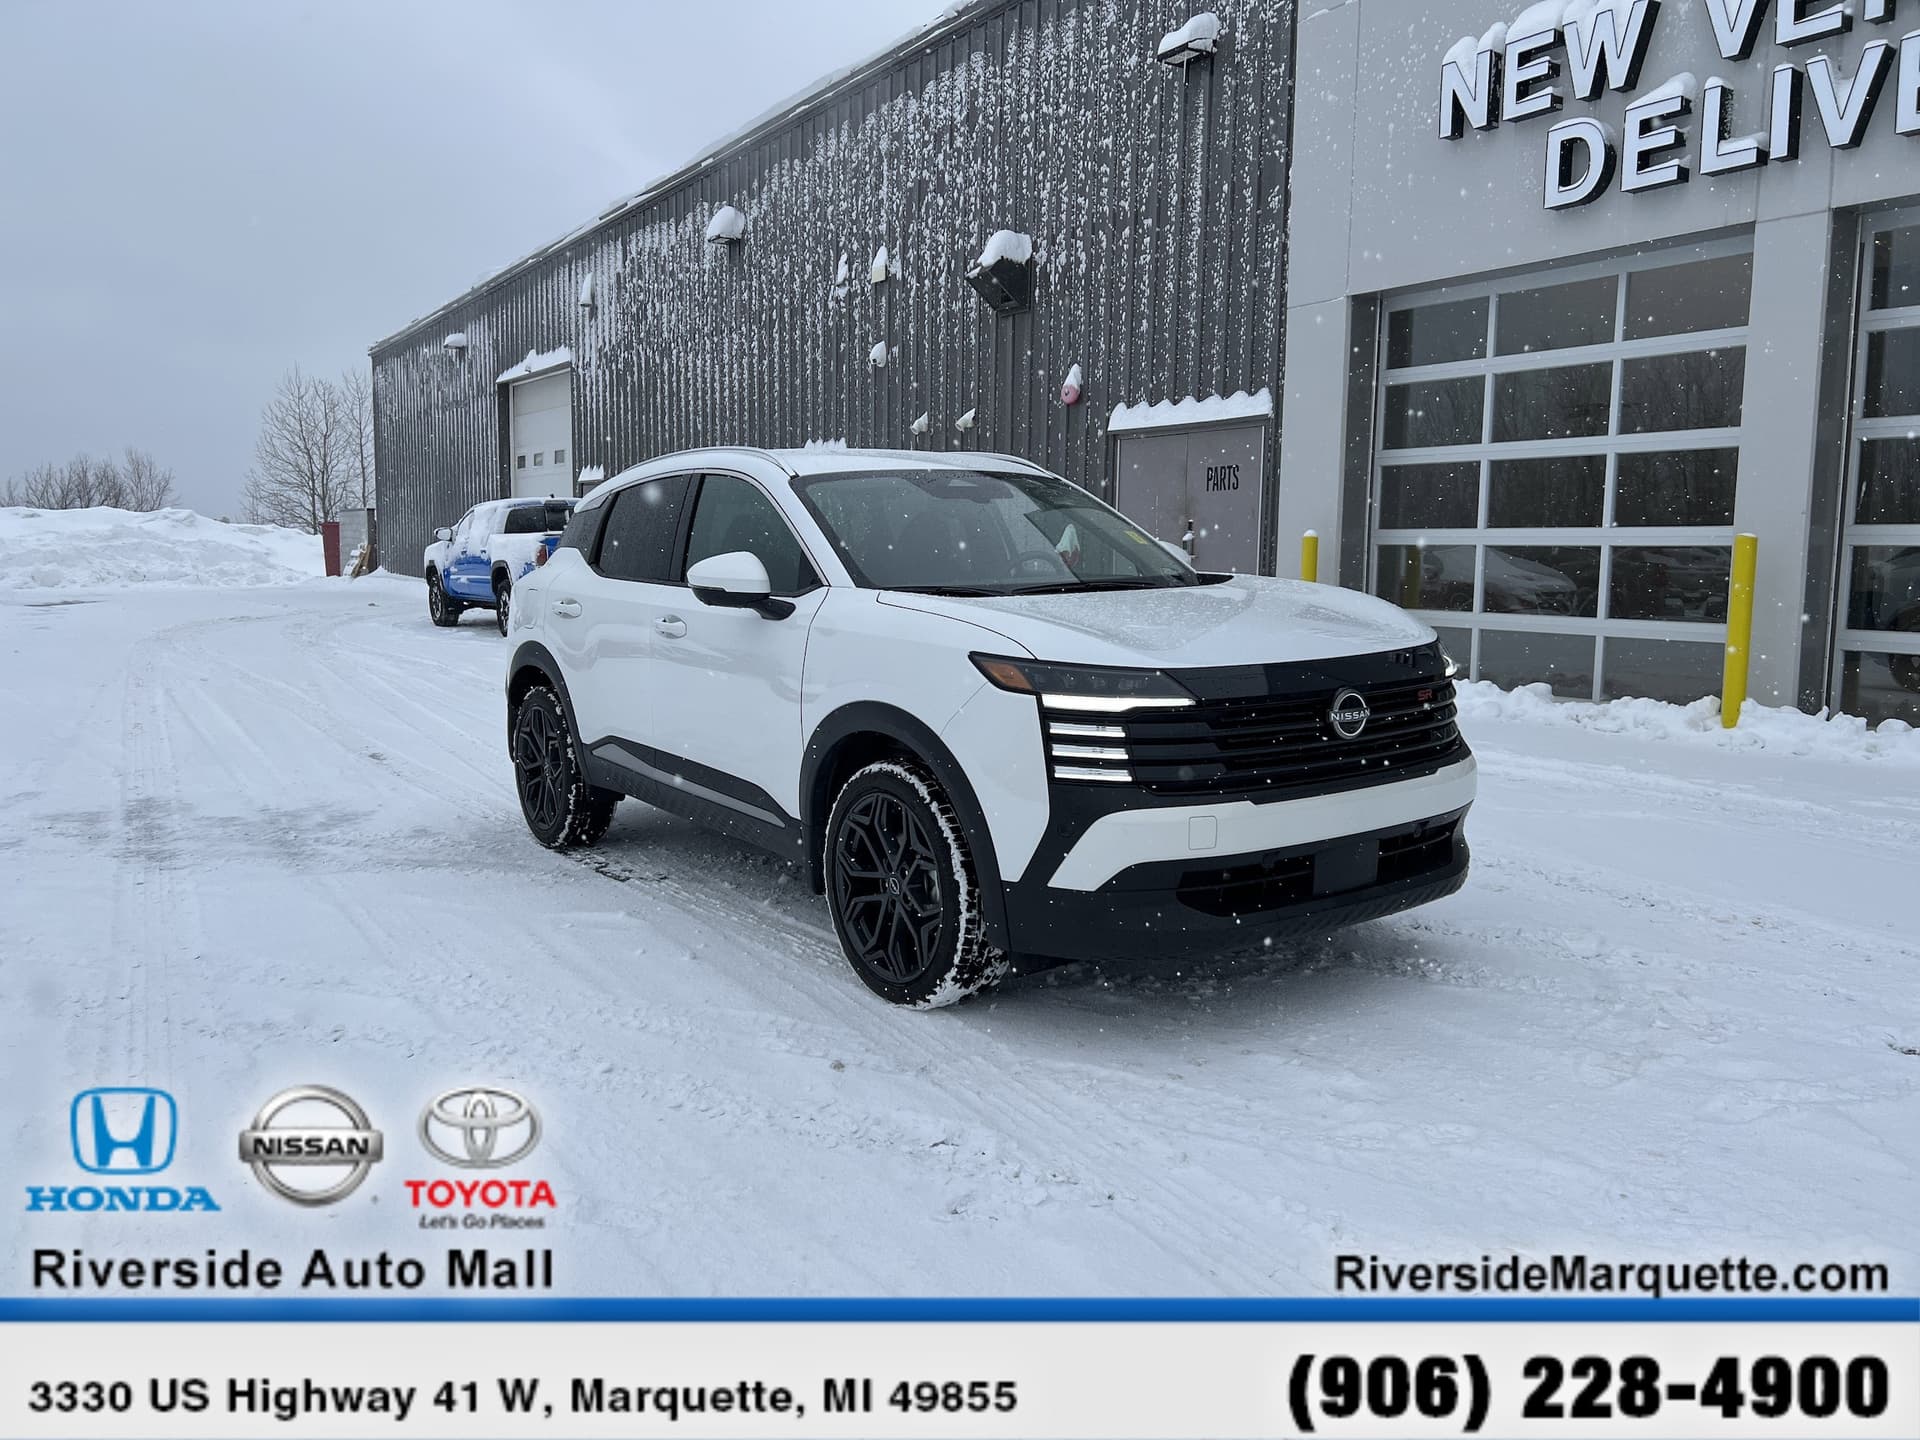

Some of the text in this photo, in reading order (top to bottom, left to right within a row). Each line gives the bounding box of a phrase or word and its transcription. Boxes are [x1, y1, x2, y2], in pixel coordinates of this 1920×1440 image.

[1438, 0, 1661, 140] NEW
[1205, 464, 1241, 492] PARTS
[1417, 689, 1433, 701] SR
[1330, 708, 1370, 722] NISSAN
